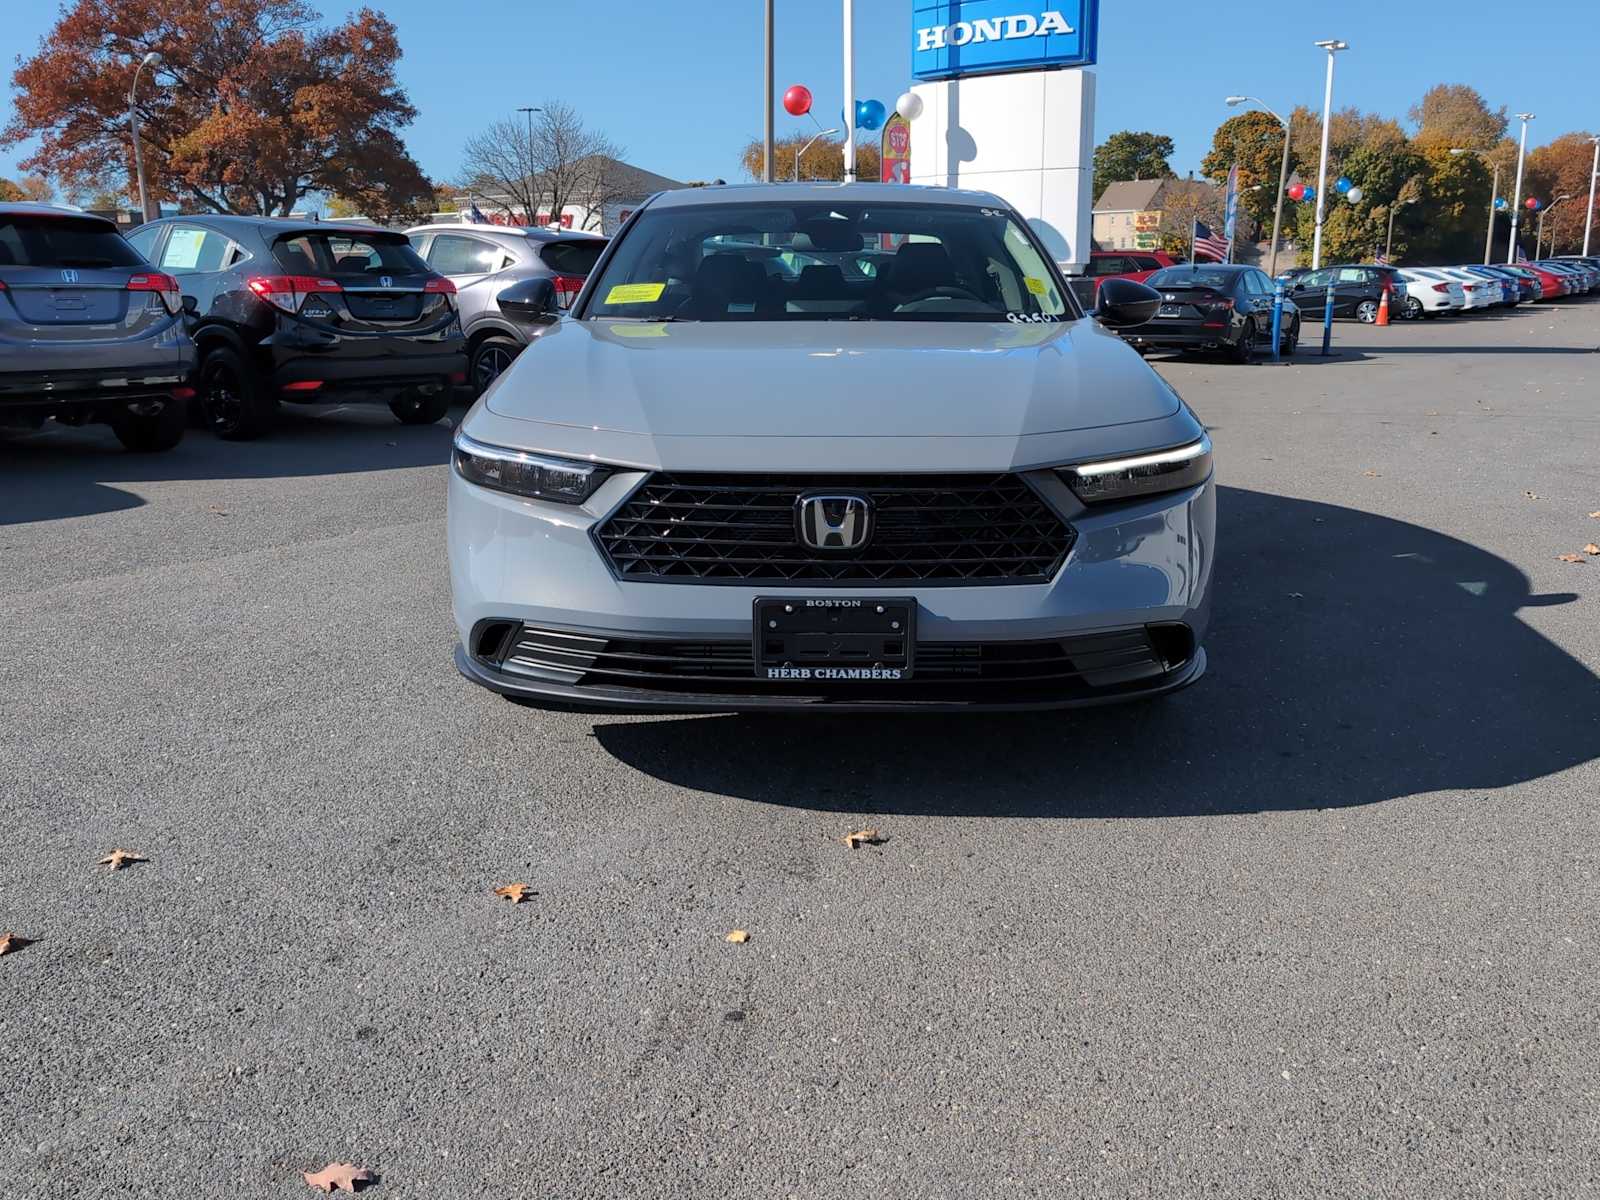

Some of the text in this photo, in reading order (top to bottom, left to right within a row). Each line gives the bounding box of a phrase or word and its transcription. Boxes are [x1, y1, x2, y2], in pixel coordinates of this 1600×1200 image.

[916, 10, 1074, 51] HONDA
[806, 599, 861, 607] BOSTON
[767, 668, 901, 680] HERB CHAMBERS
